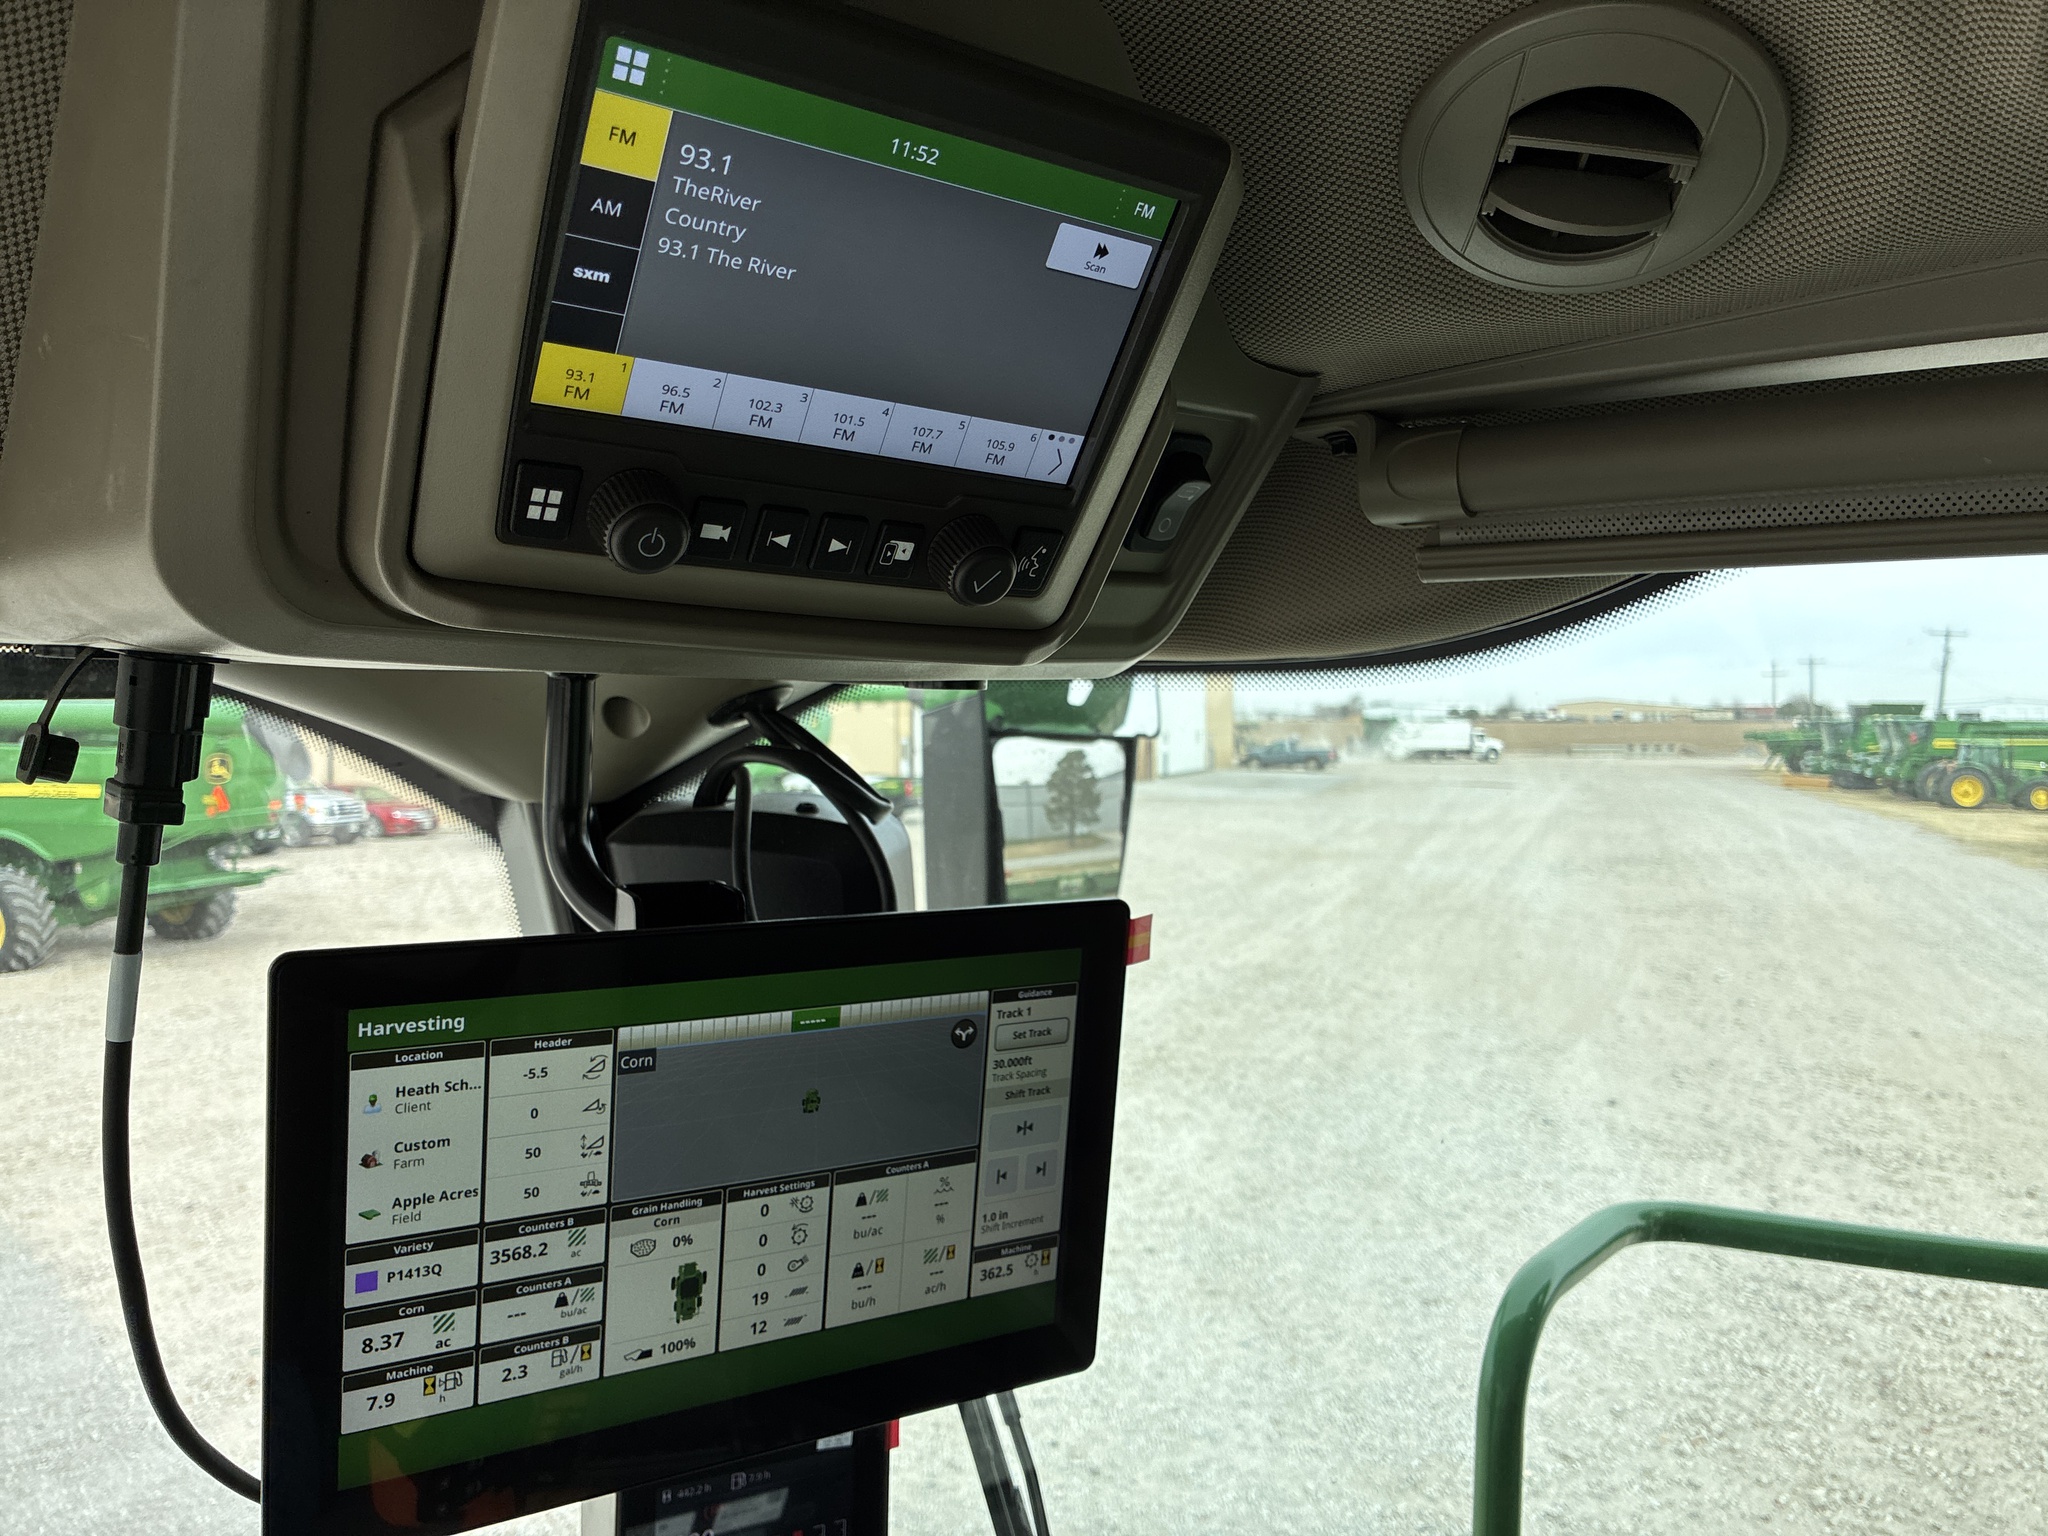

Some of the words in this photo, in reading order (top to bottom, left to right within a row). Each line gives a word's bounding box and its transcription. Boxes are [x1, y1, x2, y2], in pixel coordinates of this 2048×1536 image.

[608, 126, 637, 147] FM
[891, 138, 940, 166] 11:52
[679, 144, 732, 175] 93.1
[672, 176, 761, 212] TheRiver
[590, 198, 622, 218] AM
[1134, 202, 1156, 220] FM
[664, 208, 747, 243] Country
[658, 238, 699, 260] 93.1
[707, 248, 742, 270] The
[747, 258, 797, 281] River
[1084, 261, 1107, 274] Scan
[573, 267, 611, 283] sxm
[622, 363, 627, 373] 1
[565, 369, 595, 383] 93.1
[713, 378, 721, 388] 2
[564, 386, 590, 401] FM
[662, 384, 690, 398] 96.5
[800, 393, 808, 402] 3
[660, 400, 684, 415] FM
[748, 399, 783, 413] 102.3
[882, 408, 890, 417] 4
[749, 414, 773, 429] FM
[834, 412, 866, 427] 101.5
[958, 421, 966, 430] 5
[832, 428, 856, 442] FM
[912, 426, 943, 440] 107.7
[1030, 434, 1037, 442] 6
[912, 441, 933, 454] FM
[986, 439, 1015, 452] 105.9
[985, 453, 1006, 466] FM
[1018, 989, 1053, 999] Guidance
[997, 1008, 1024, 1019] Track
[1026, 1007, 1032, 1016] 1
[358, 1015, 465, 1037] Harvesting
[1013, 1030, 1027, 1039] Set
[1029, 1027, 1052, 1038] Track
[534, 1037, 572, 1049] Header
[395, 1051, 443, 1063] Location
[620, 1056, 653, 1069] Corn
[993, 1056, 1033, 1070] 30.000ft
[523, 1067, 548, 1079] -5.5
[992, 1072, 1014, 1082] Track
[1016, 1067, 1047, 1079] Spacing
[395, 1083, 440, 1098] Heath
[444, 1079, 482, 1093] Sch...
[1005, 1090, 1026, 1100] Shift
[1028, 1086, 1051, 1097] Track
[395, 1101, 431, 1115] Client
[530, 1108, 539, 1119] 0
[394, 1137, 451, 1154] Custom
[525, 1147, 541, 1159] 50
[394, 1157, 425, 1170] Farm
[886, 1162, 922, 1175] Counters
[923, 1161, 929, 1169] A
[523, 1187, 540, 1199] 50
[743, 1186, 778, 1198] Harvest
[779, 1180, 816, 1192] Settings
[391, 1192, 435, 1210] Apple
[439, 1186, 479, 1202] Acres
[632, 1206, 658, 1216] Grain
[660, 1198, 703, 1212] Handling
[761, 1204, 769, 1217] 0
[392, 1211, 422, 1225] Field
[653, 1216, 680, 1228] Corn
[982, 1212, 997, 1223] 1.0
[999, 1211, 1008, 1220] in
[518, 1220, 563, 1235] Counters
[567, 1217, 574, 1226] B
[981, 1223, 999, 1235] Shift
[1001, 1215, 1044, 1230] Increment
[853, 1226, 884, 1240] bu/ac
[673, 1234, 693, 1247] 0%
[759, 1234, 768, 1247] 0
[394, 1241, 434, 1255] Variety
[490, 1242, 548, 1265] 3568.2
[571, 1249, 581, 1258] ac
[1001, 1243, 1032, 1256] Machine
[387, 1264, 442, 1282] P1413Q
[757, 1263, 766, 1276] 0
[980, 1264, 1014, 1282] 362.5
[516, 1280, 561, 1294] Counters
[564, 1277, 572, 1286] A
[925, 1283, 946, 1295] ac/h
[752, 1291, 769, 1305] 19
[851, 1296, 876, 1310] bu/h
[399, 1304, 425, 1316] Corn
[561, 1307, 587, 1319] bu/ac
[751, 1321, 768, 1335] 12
[362, 1331, 405, 1353] 8.37
[435, 1338, 451, 1349] ac
[514, 1338, 558, 1354] Counters
[562, 1335, 570, 1345] B
[660, 1338, 696, 1354] 100%
[386, 1364, 433, 1381] Machine
[502, 1365, 528, 1383] 2.3
[559, 1365, 583, 1379] gal/h
[367, 1393, 395, 1411] 7.9
[439, 1394, 446, 1403] h
